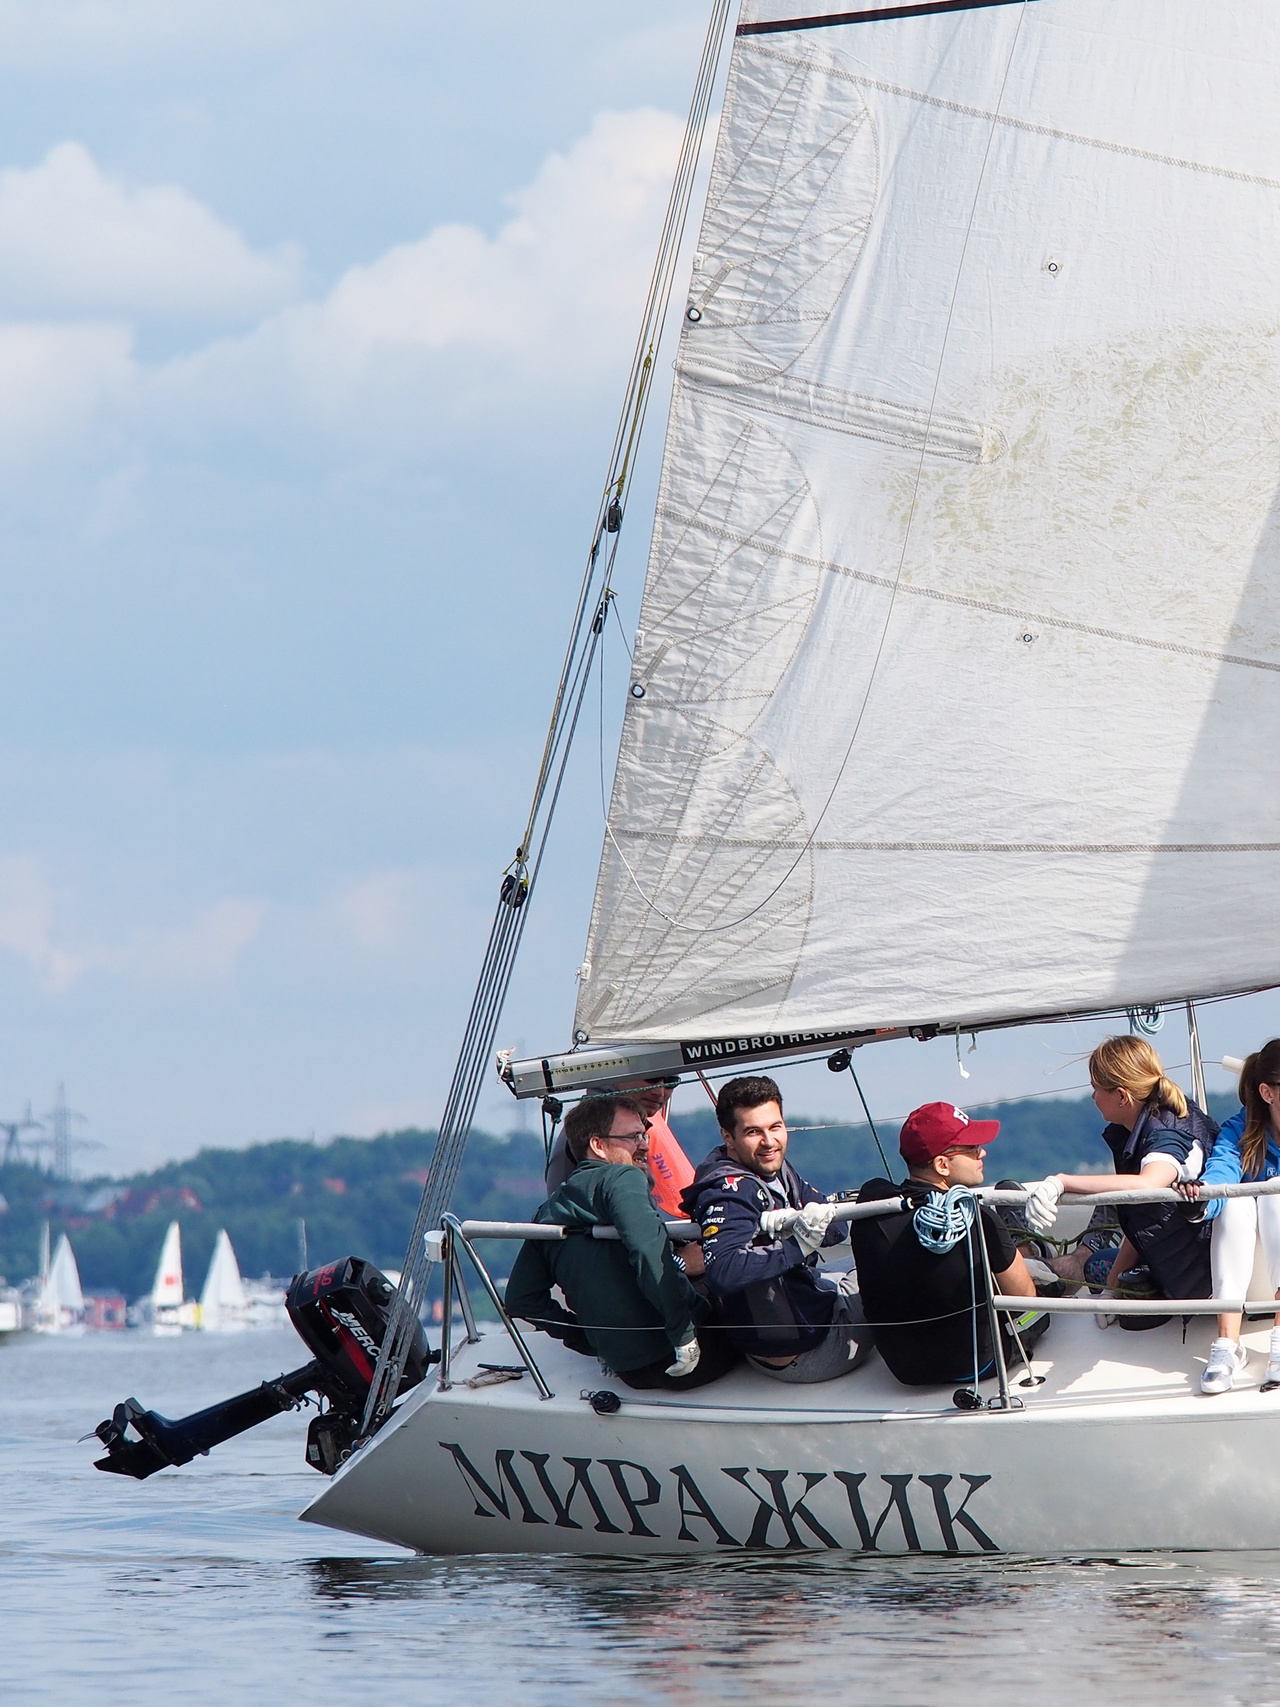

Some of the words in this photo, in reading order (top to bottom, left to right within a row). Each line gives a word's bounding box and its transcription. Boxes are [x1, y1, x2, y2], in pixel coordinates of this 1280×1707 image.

[652, 1152, 674, 1180] LINE
[335, 1311, 388, 1365] MERC
[438, 1440, 1000, 1551] МИРАЖИК
